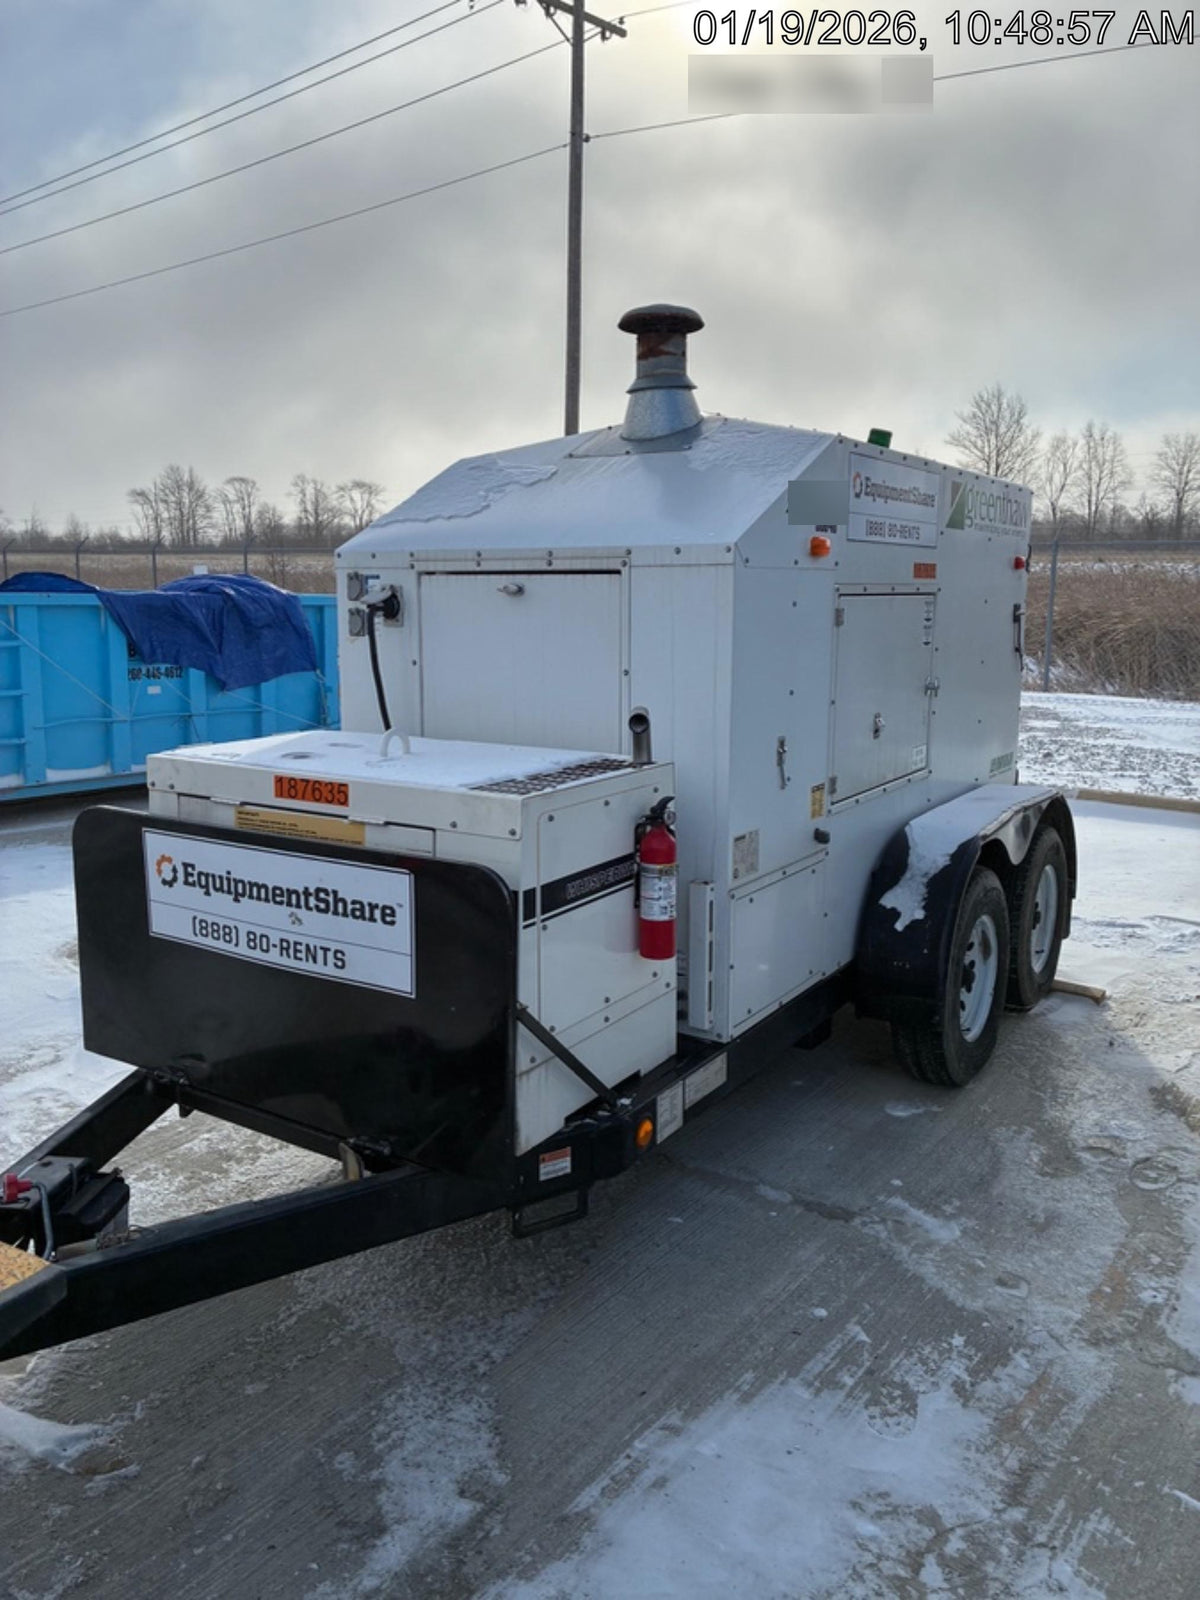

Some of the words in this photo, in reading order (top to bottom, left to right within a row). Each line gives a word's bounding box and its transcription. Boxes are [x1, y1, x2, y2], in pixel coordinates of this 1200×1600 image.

[864, 476, 936, 508] EquipmentShare
[275, 776, 349, 805] 187635
[181, 861, 398, 927] EquipmentShare
[192, 915, 240, 948] (888)
[246, 931, 346, 970] 80-RENTS
